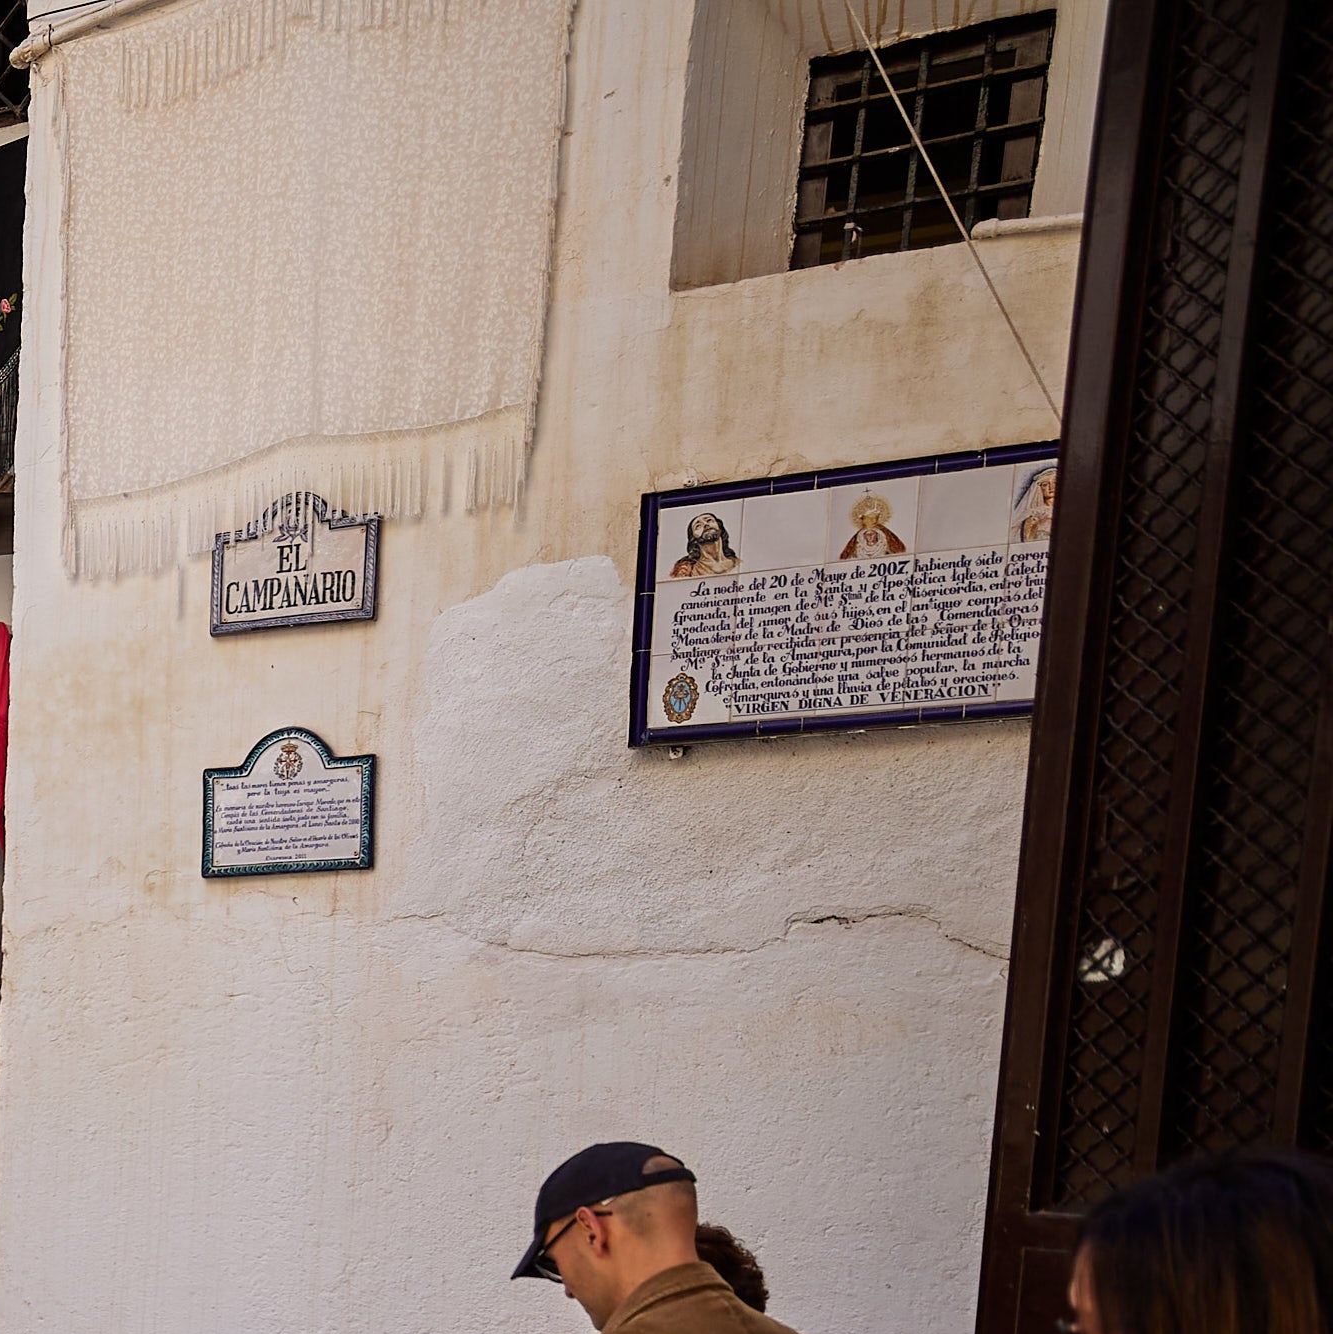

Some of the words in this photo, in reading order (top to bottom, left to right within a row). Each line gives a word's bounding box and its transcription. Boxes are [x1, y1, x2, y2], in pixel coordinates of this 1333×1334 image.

[277, 543, 307, 574] EL
[690, 582, 710, 597] La
[714, 580, 744, 594] noche
[748, 577, 766, 591] del
[769, 575, 787, 588] 20
[791, 573, 804, 586] de
[808, 568, 847, 584] Mayo
[851, 566, 865, 579] de
[914, 555, 972, 572] habiendo
[975, 551, 1003, 566] sido
[1011, 552, 1049, 562] coron
[225, 569, 355, 615] CAMPANARIO
[795, 587, 807, 597] la
[814, 582, 852, 597] Santa
[859, 584, 867, 595] y
[952, 567, 999, 585] Iglesia
[1004, 560, 1048, 576] Catedr
[672, 629, 680, 640] y
[683, 620, 730, 634] rodeada
[736, 617, 754, 629] del
[758, 617, 791, 627] amor
[796, 612, 809, 623] de
[814, 611, 837, 621] sus
[842, 606, 875, 620] hijos,
[876, 607, 891, 615] en
[895, 601, 907, 613] el
[912, 599, 962, 611] antiguo
[1023, 587, 1043, 600] del
[674, 607, 730, 625] Granada,
[733, 605, 744, 618] la
[749, 605, 791, 615] imagen
[796, 599, 809, 610] de
[865, 592, 879, 603] de
[882, 590, 895, 601] la
[899, 581, 986, 601] Misericordia,
[1025, 575, 1044, 586] triu
[671, 631, 742, 648] Monasterio
[745, 628, 758, 640] de
[762, 627, 774, 639] la
[826, 620, 840, 632] de
[848, 618, 883, 630] Dios
[888, 614, 902, 626] de
[906, 613, 928, 625] las
[940, 603, 1038, 621] Comendadoras
[671, 647, 720, 662] Santiago
[726, 641, 763, 654] siendo
[768, 635, 816, 650] recibida
[820, 638, 836, 646] en
[840, 631, 901, 646] presencia
[905, 624, 927, 638] del
[932, 622, 968, 635] Señor
[972, 619, 987, 631] de
[991, 617, 1005, 630] la
[1007, 614, 1041, 629] Ora
[711, 668, 722, 681] la
[726, 666, 761, 679] Junta
[764, 664, 777, 676] de
[783, 661, 837, 676] Gobierno
[840, 662, 847, 672] y
[851, 653, 917, 668] numerosos
[922, 647, 985, 661] hermanos
[987, 643, 1003, 655] de
[1008, 642, 1021, 654] la
[744, 653, 759, 665] de
[763, 652, 775, 663] la
[780, 649, 855, 662] Amargura,
[854, 646, 878, 658] por
[881, 640, 893, 652] la
[897, 633, 967, 651] Comunidad
[972, 632, 986, 644] de
[989, 627, 1040, 644] Religio
[723, 689, 799, 703] Amarguras
[801, 690, 810, 701] y
[813, 688, 833, 697] una
[838, 682, 872, 694] lluvia
[876, 679, 890, 691] de
[941, 678, 948, 687] y
[953, 671, 1019, 684] oraciones.
[838, 673, 859, 682] una
[866, 666, 899, 679] salve
[906, 662, 957, 679] popular,
[963, 659, 975, 671] la
[982, 654, 1030, 669] marcha
[799, 696, 843, 709] DIGNA
[850, 694, 868, 705] DE
